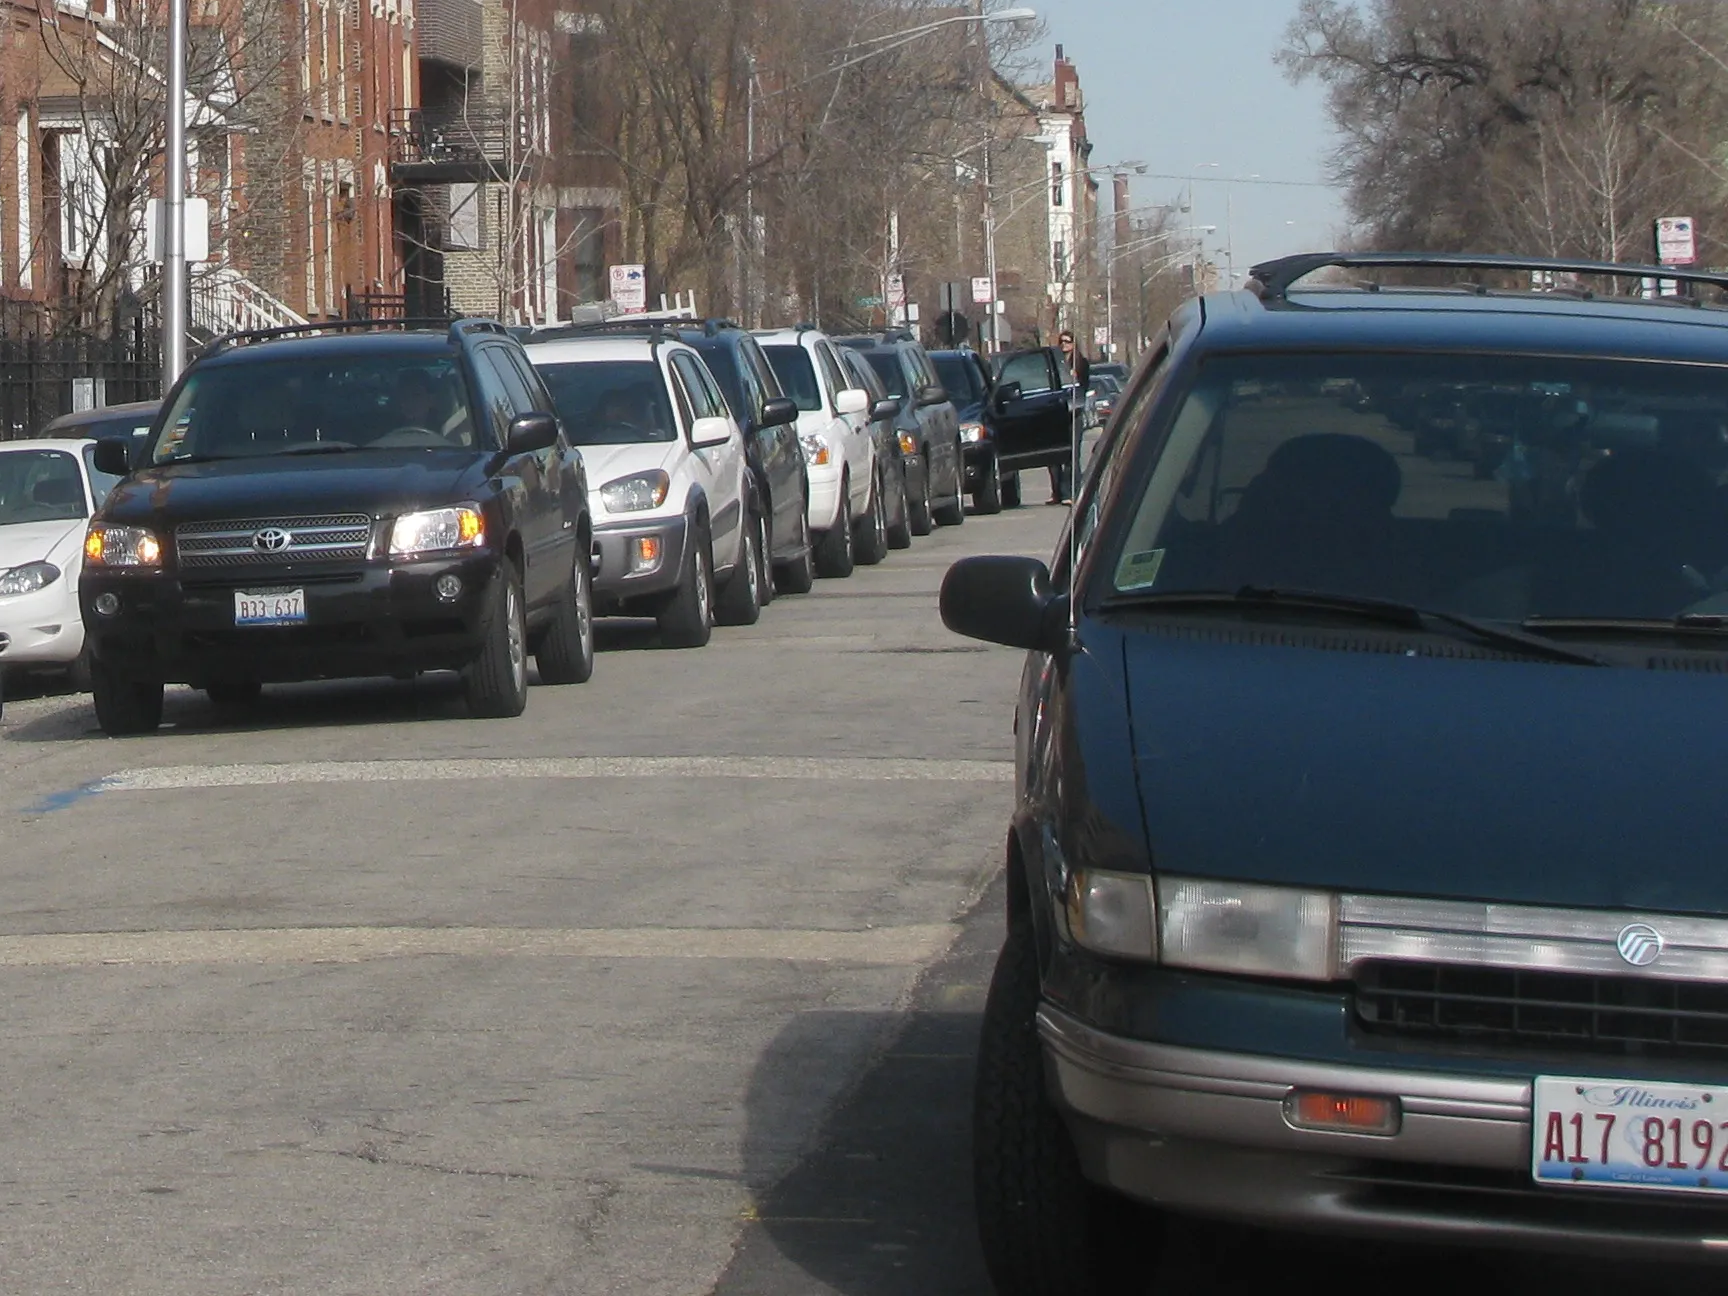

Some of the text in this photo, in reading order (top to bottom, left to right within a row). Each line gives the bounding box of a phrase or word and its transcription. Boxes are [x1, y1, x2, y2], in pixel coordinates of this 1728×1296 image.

[274, 598, 299, 616] 637
[1584, 1085, 1699, 1110] Illinois
[1543, 1111, 1617, 1165] A17
